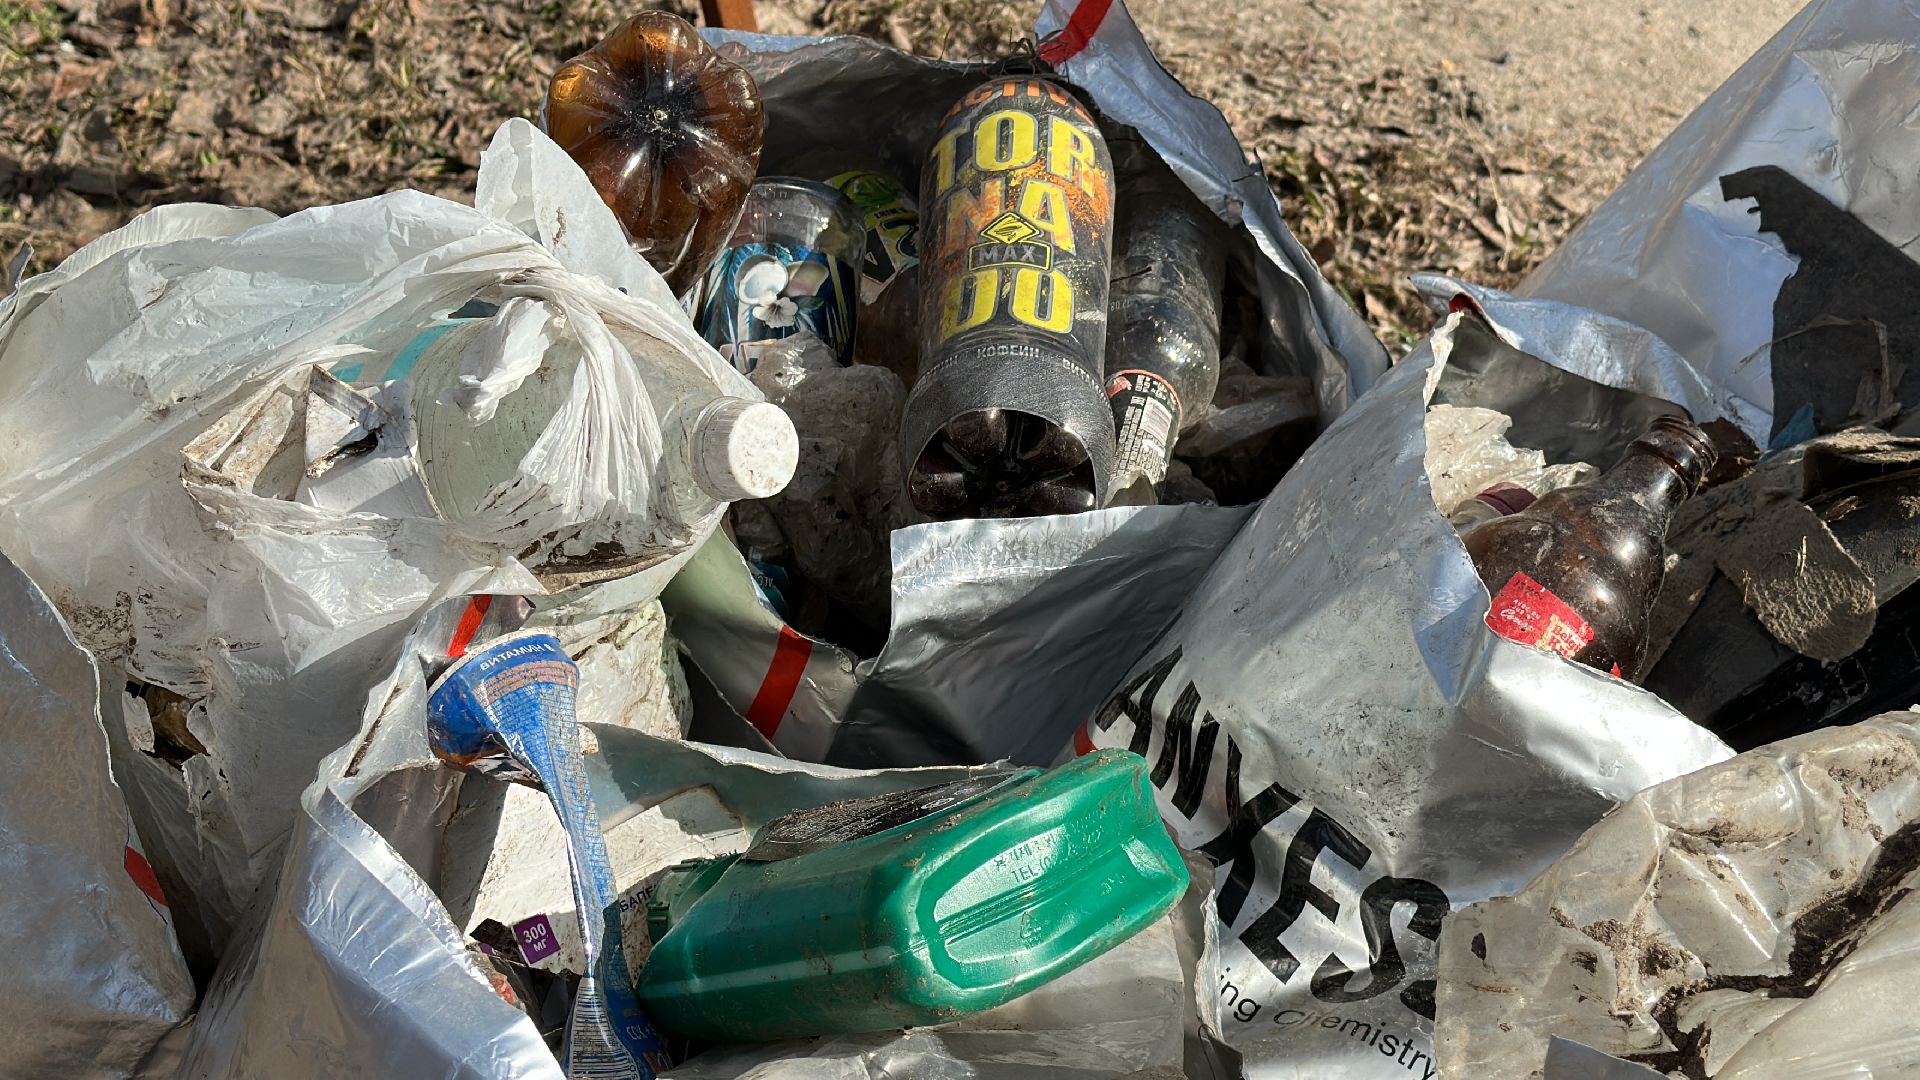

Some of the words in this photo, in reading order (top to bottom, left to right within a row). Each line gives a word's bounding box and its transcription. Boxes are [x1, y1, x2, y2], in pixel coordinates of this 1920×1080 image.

[929, 110, 1095, 198] TOR
[978, 243, 1037, 265] MAX
[940, 267, 1075, 334] DO
[976, 344, 1040, 359] КОФЕИН
[480, 643, 546, 671] ВИТАМИН
[523, 923, 547, 943] 300
[1272, 1009, 1436, 1080] Chemistry
